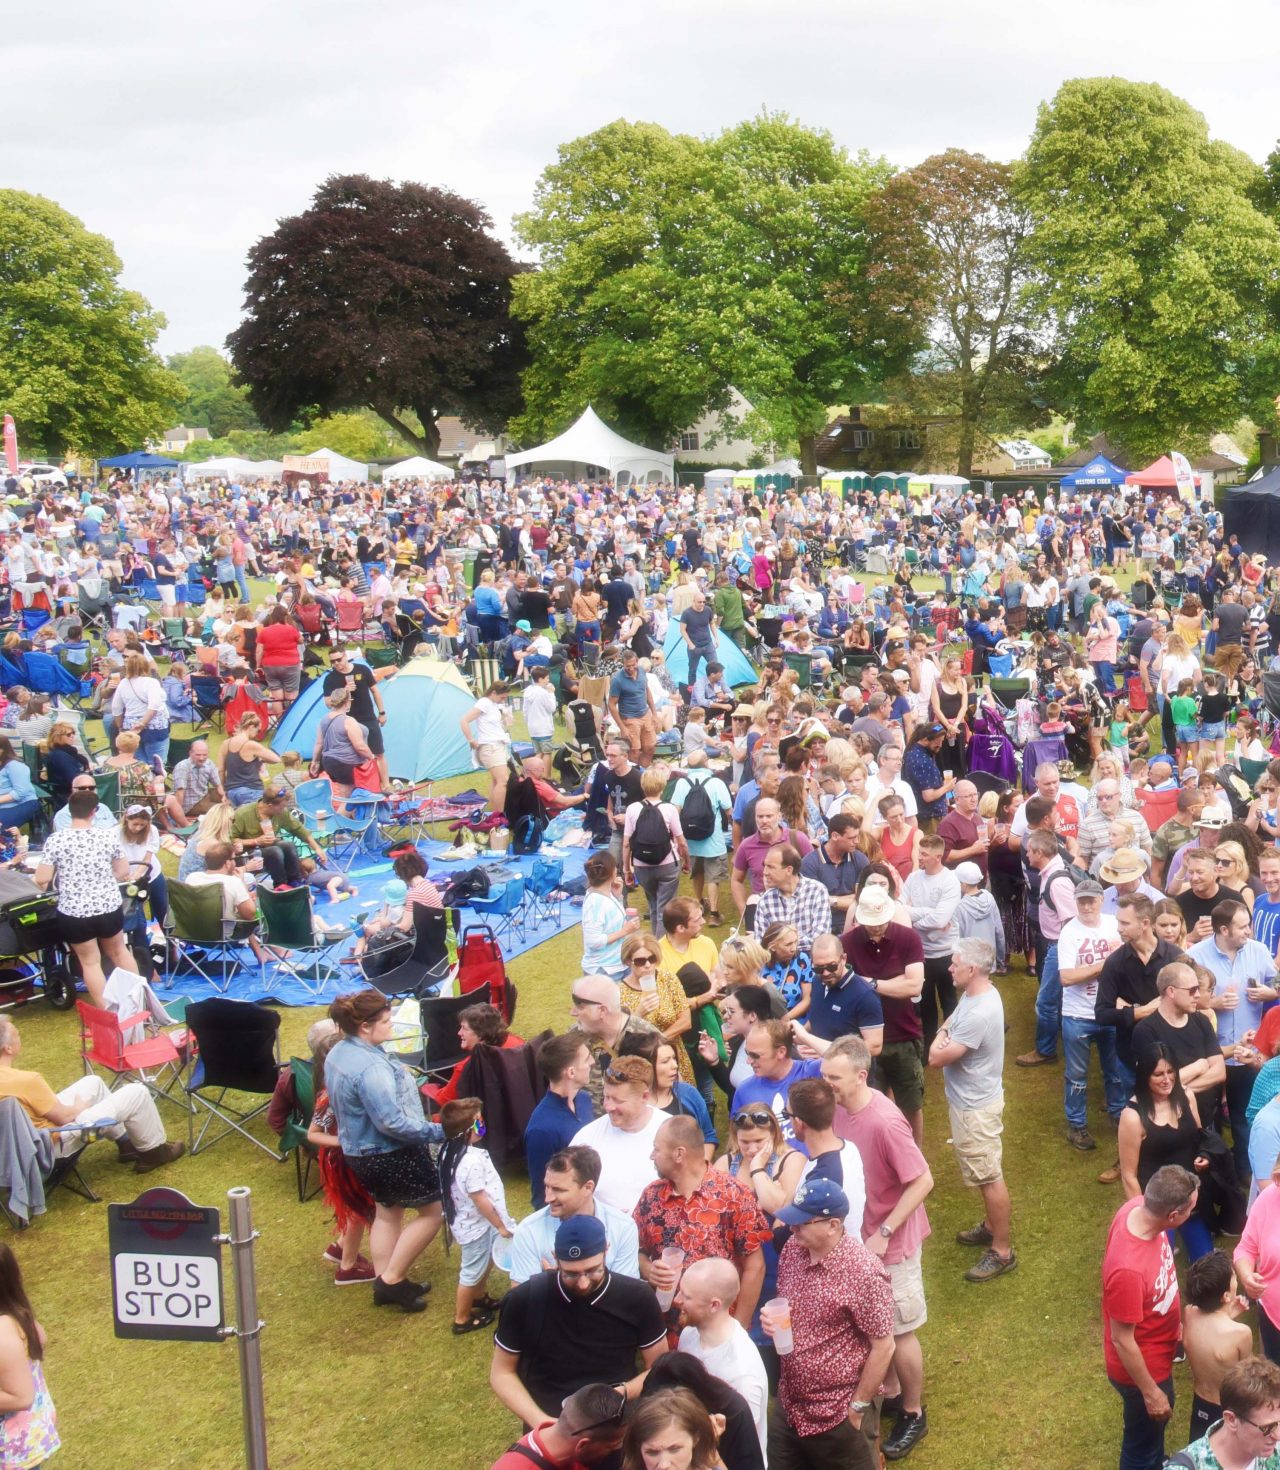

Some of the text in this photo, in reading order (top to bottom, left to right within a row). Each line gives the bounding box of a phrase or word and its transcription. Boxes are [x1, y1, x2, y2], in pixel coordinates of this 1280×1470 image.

[1253, 908, 1280, 956] OVE
[133, 1261, 201, 1288] BUS
[125, 1291, 212, 1319] STOP
